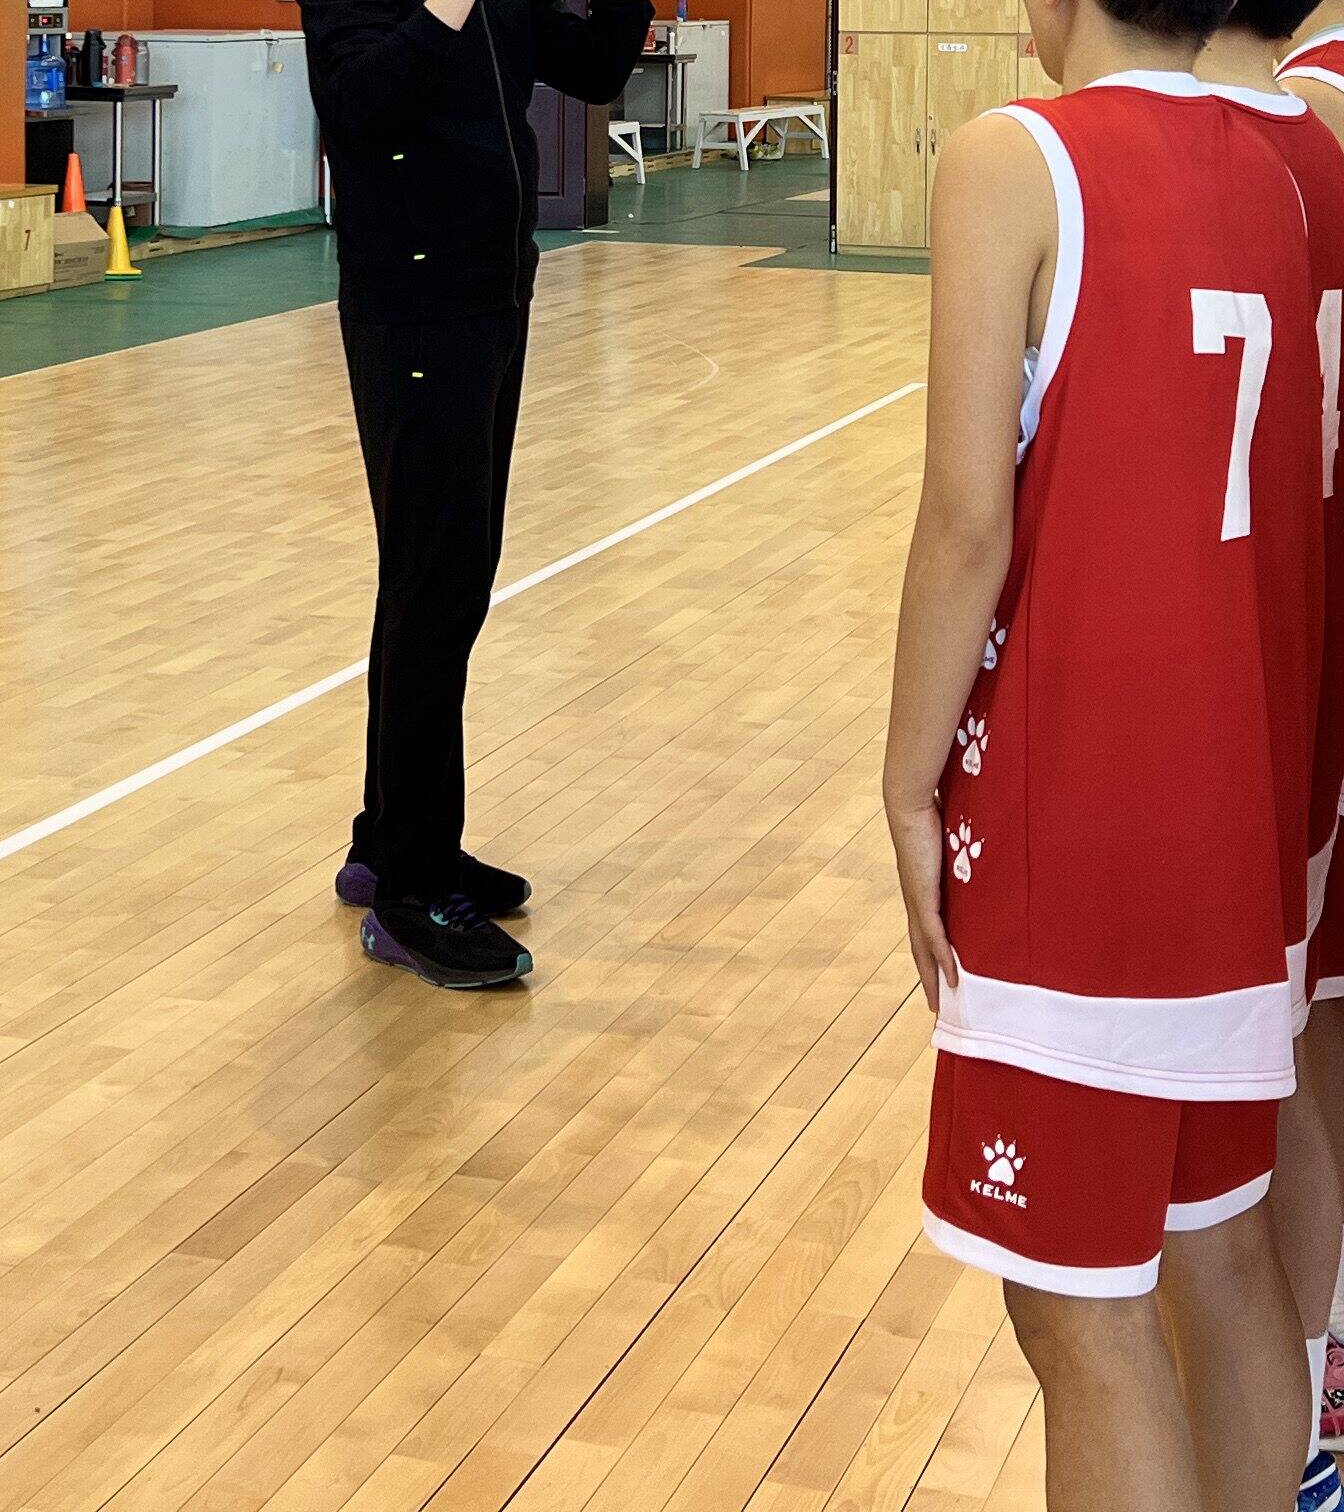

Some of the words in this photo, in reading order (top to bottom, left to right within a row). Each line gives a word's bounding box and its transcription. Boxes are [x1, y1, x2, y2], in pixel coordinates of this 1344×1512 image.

[844, 35, 855, 55] 2
[1024, 39, 1037, 58] 4
[24, 229, 31, 252] 7
[1189, 287, 1273, 542] 7
[969, 1178, 1028, 1209] KELME
